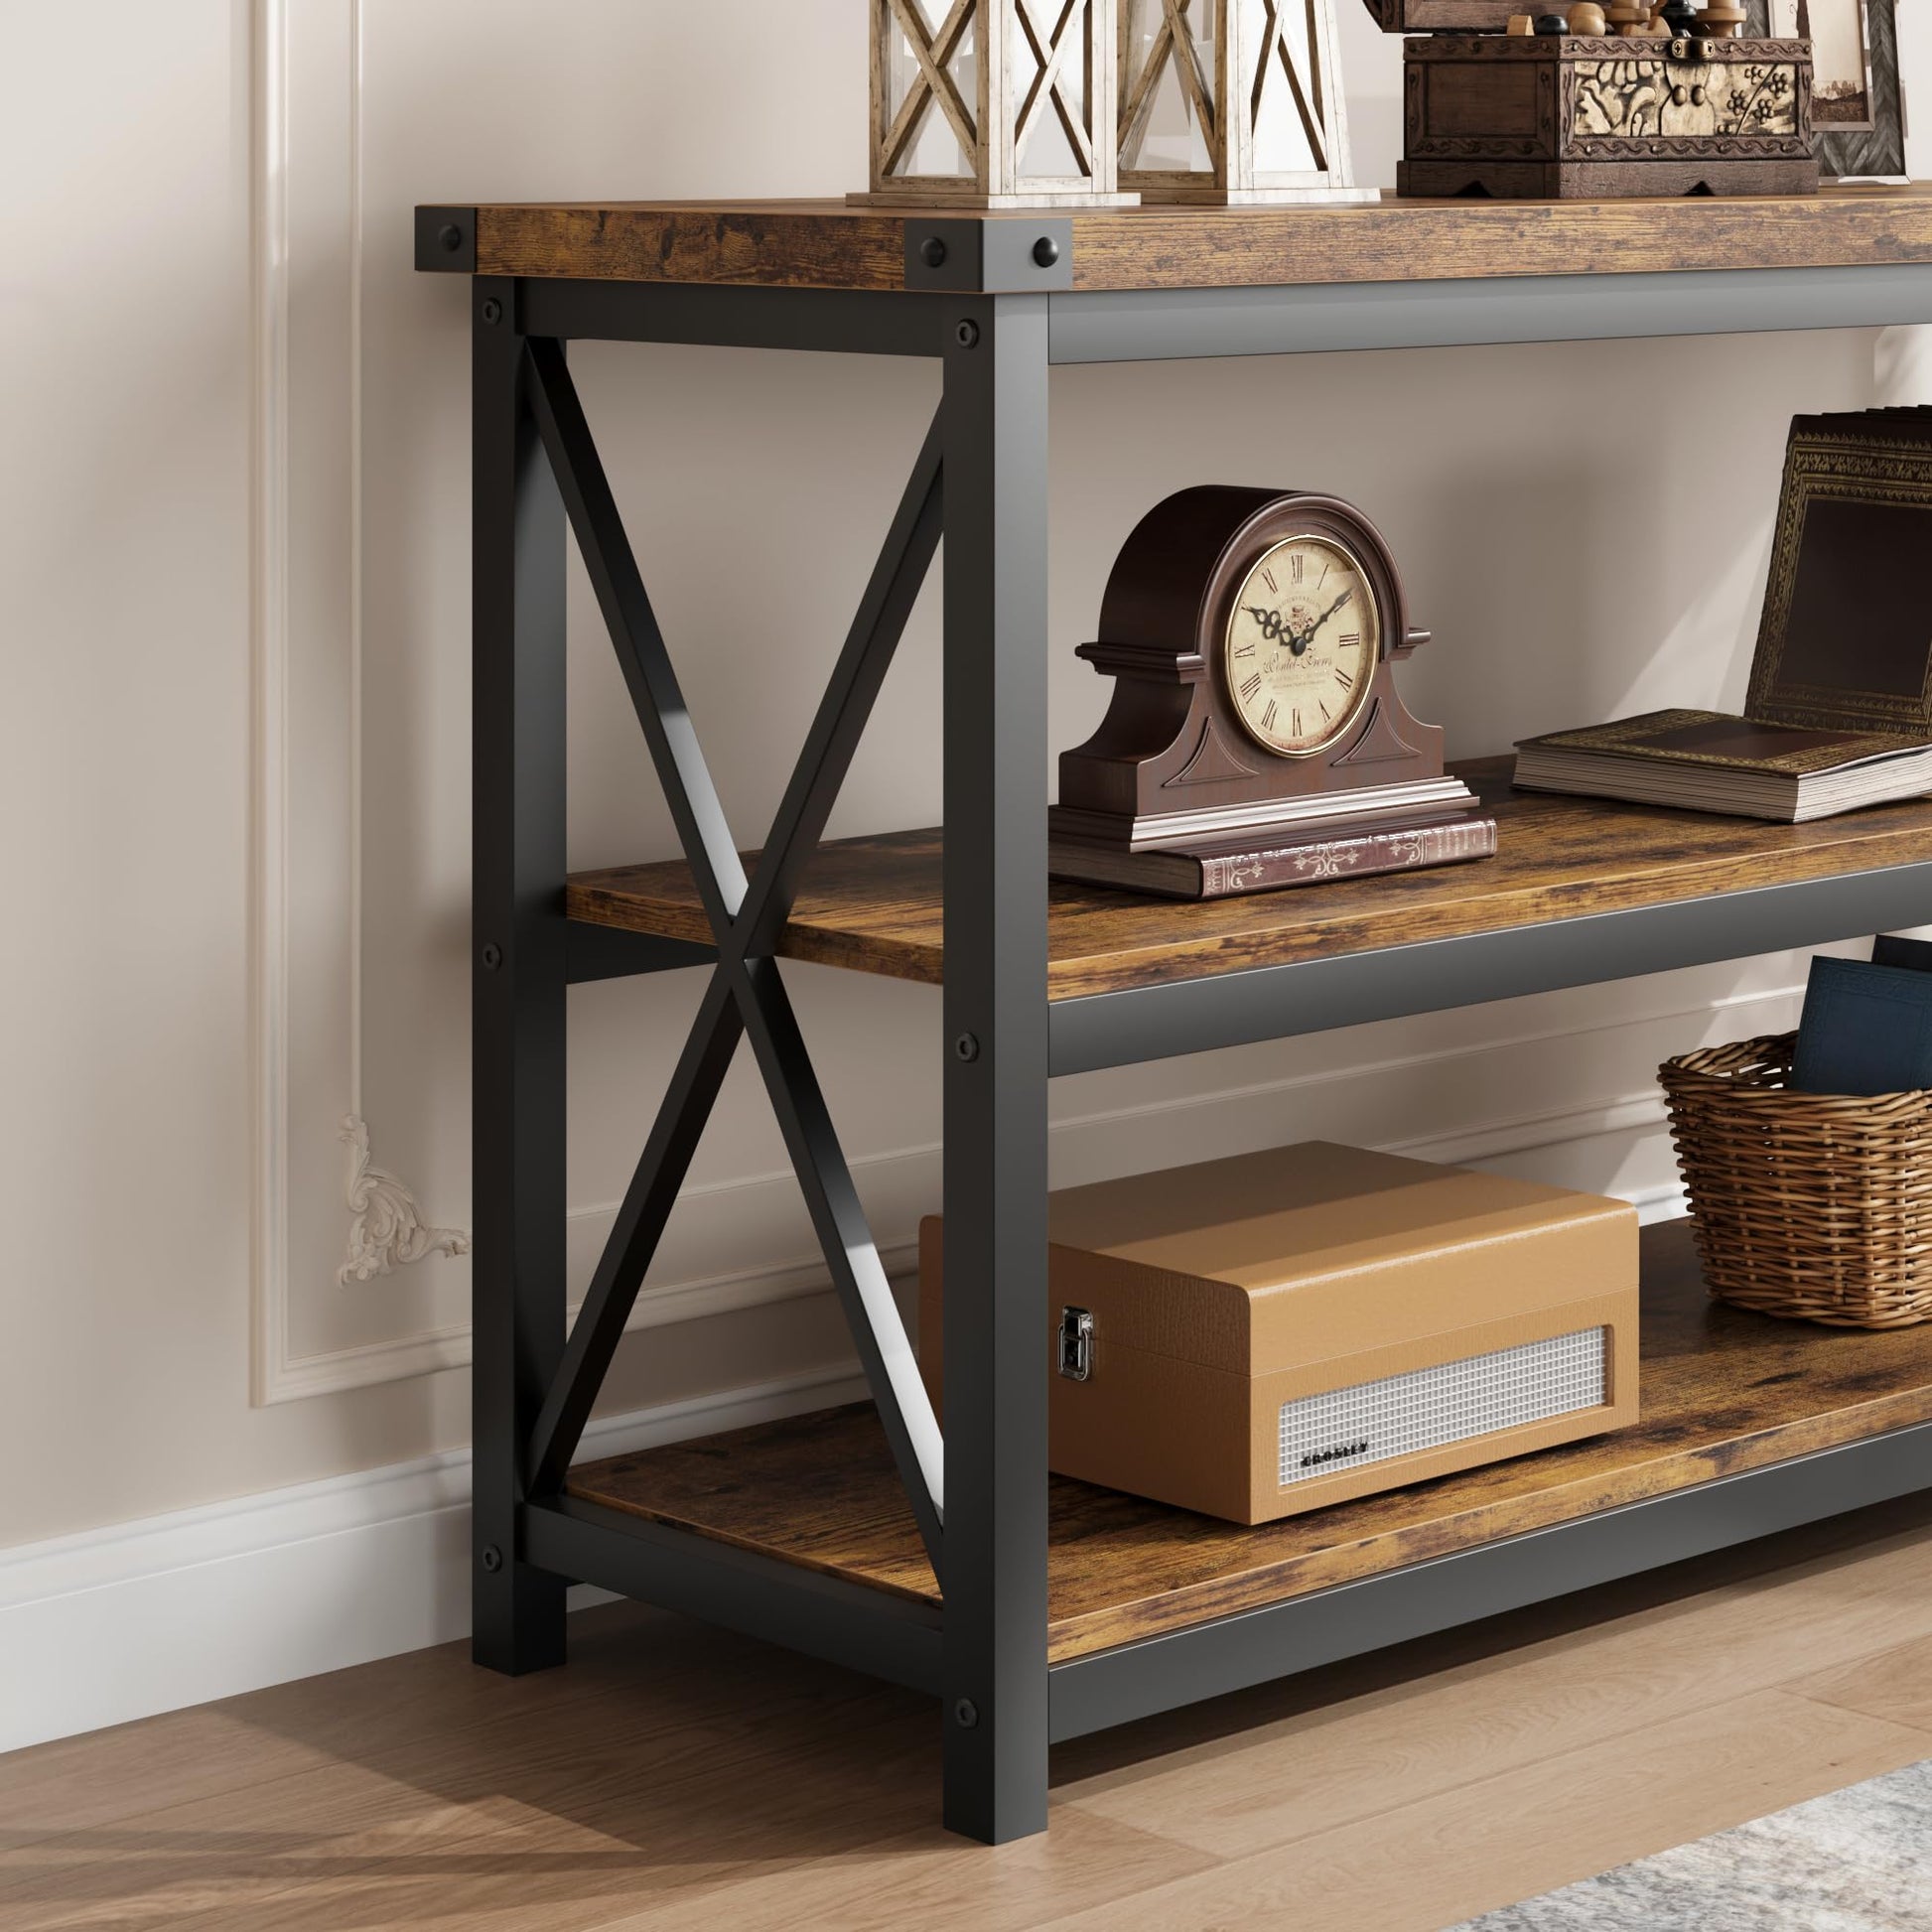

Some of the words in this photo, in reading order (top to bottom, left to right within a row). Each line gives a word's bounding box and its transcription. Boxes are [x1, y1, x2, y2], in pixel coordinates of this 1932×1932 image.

[1291, 554, 1304, 585] XII
[1338, 631, 1360, 648] III
[1301, 1441, 1368, 1467] CROSLEY
